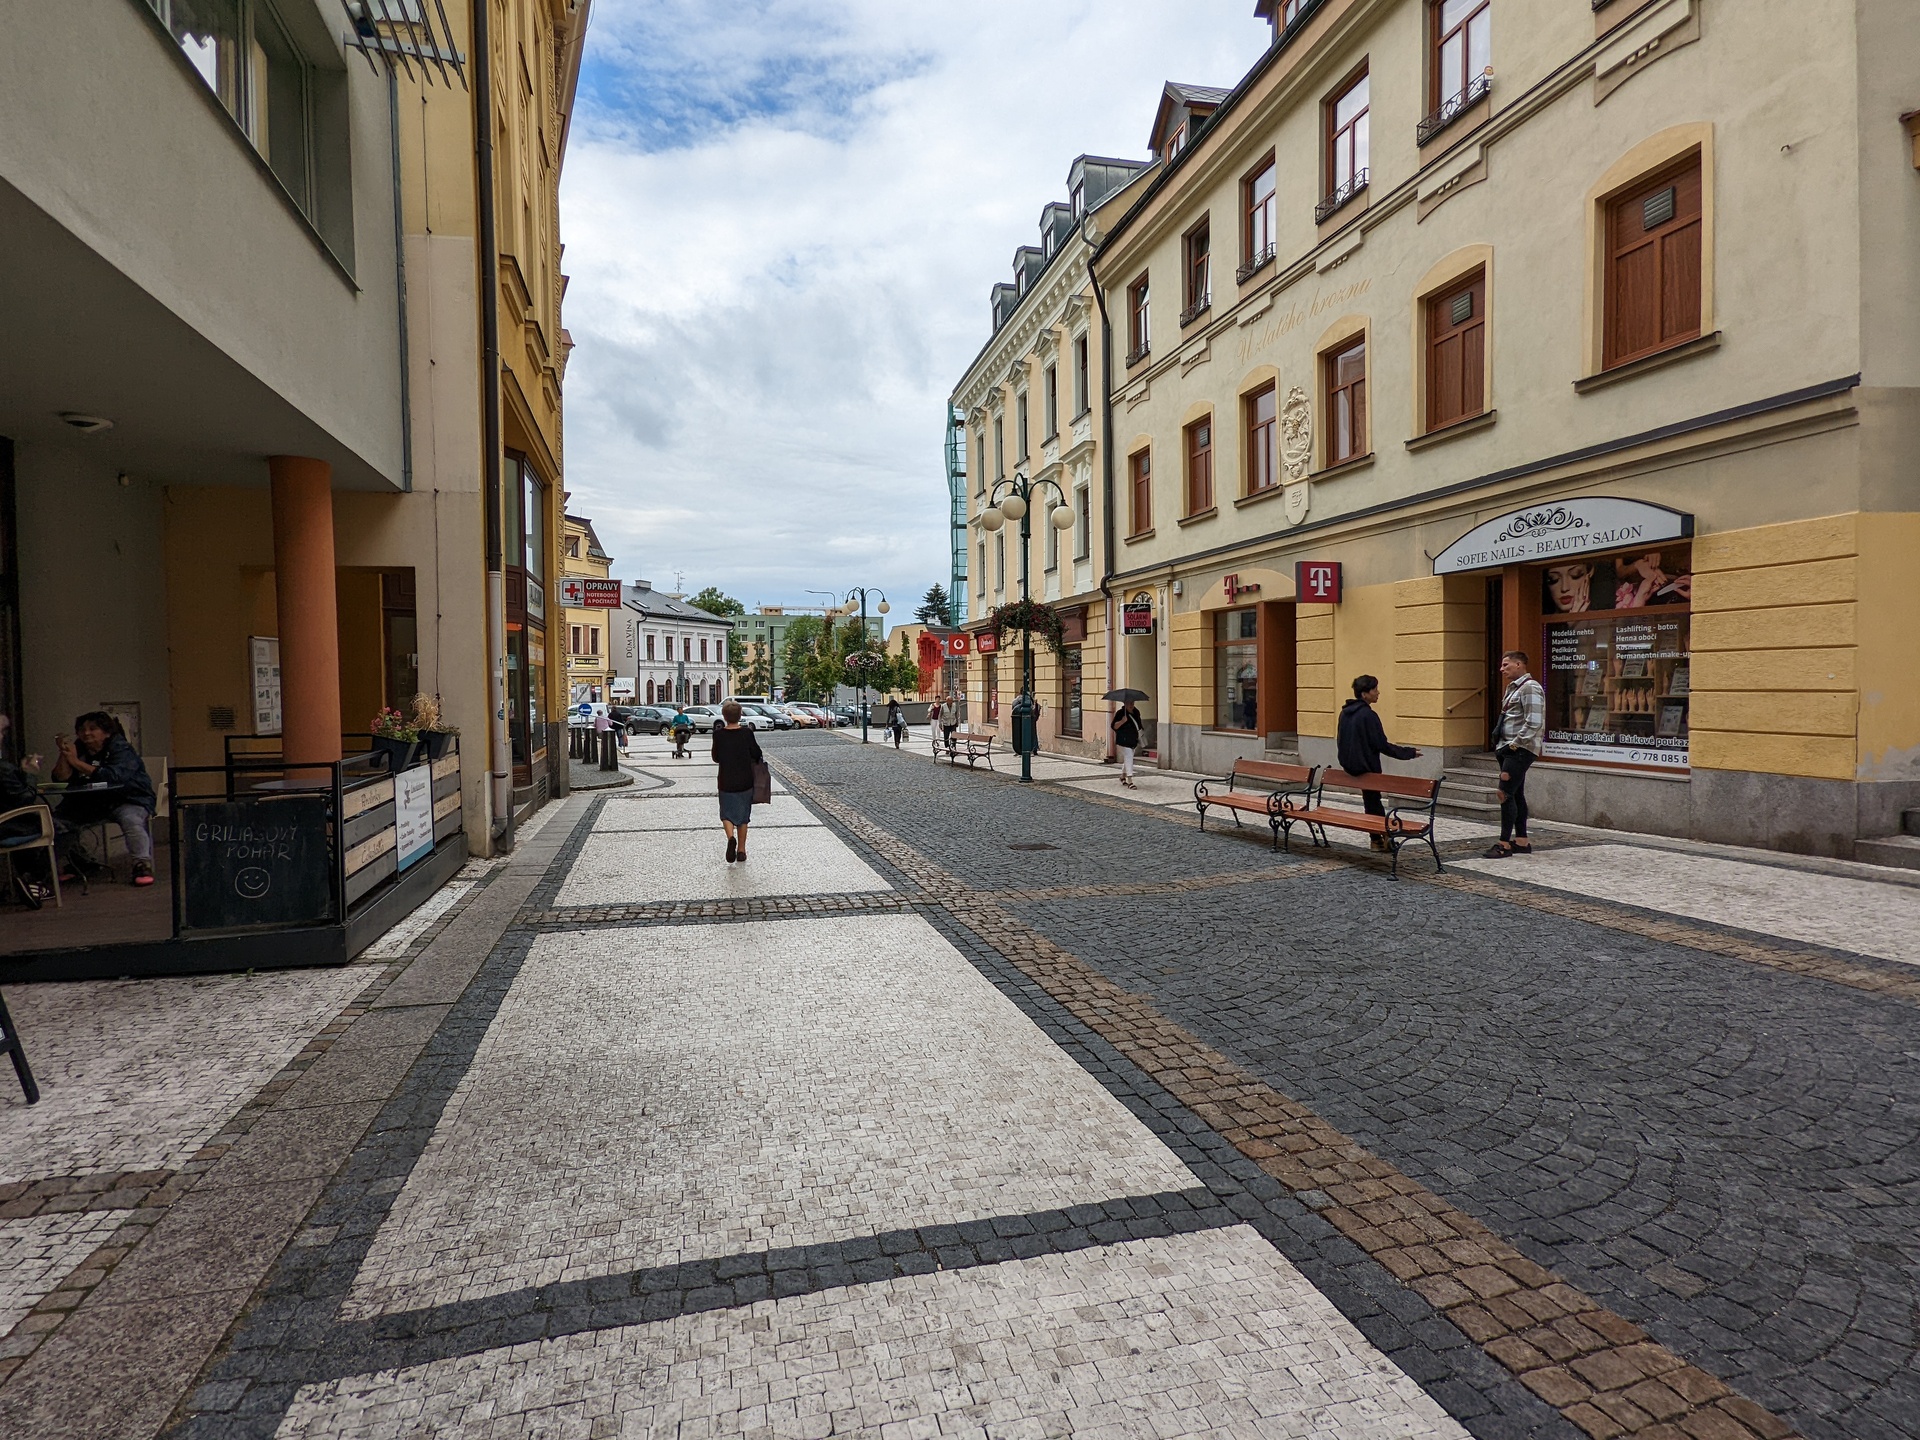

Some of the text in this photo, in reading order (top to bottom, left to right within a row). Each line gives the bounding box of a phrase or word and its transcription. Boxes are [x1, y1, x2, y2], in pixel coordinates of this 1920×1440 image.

[1309, 278, 1372, 319] hroznu
[1456, 553, 1488, 567] SOFIE
[1490, 545, 1525, 562] NAILS
[1536, 535, 1589, 554] BEAUTY
[1593, 525, 1643, 545] SALON
[586, 582, 619, 591] OPRAVY
[1310, 567, 1331, 596] T
[1552, 629, 1576, 637] Modeláž
[1616, 625, 1652, 633] Lashlifting
[1616, 650, 1691, 660] Permanentní make-up
[1548, 730, 1615, 743] Nehty na počkání
[1619, 732, 1655, 745] Dárkové
[1642, 752, 1658, 762] 778
[1661, 753, 1679, 763] 085
